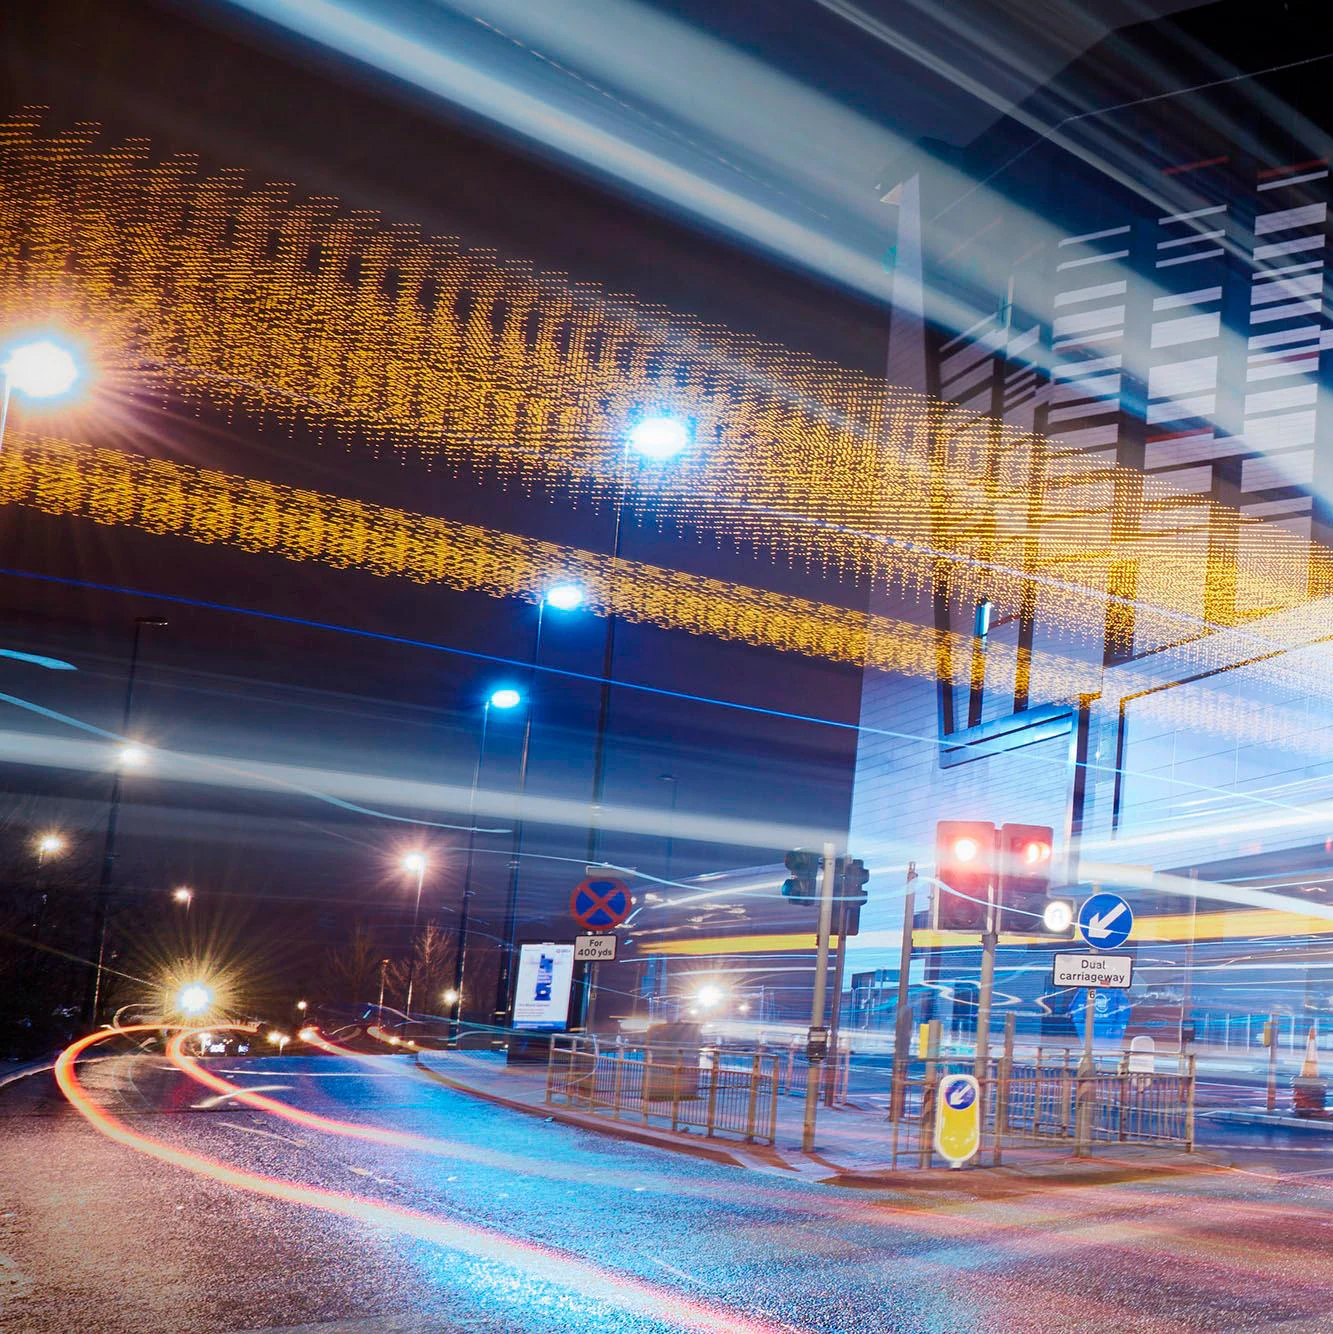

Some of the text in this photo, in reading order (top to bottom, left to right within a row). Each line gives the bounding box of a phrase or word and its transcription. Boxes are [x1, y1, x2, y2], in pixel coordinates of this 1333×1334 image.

[589, 939, 603, 947] For
[578, 948, 596, 957] 400
[597, 948, 612, 958] yds
[1081, 959, 1106, 969] Dual
[1059, 972, 1125, 984] carriageway
